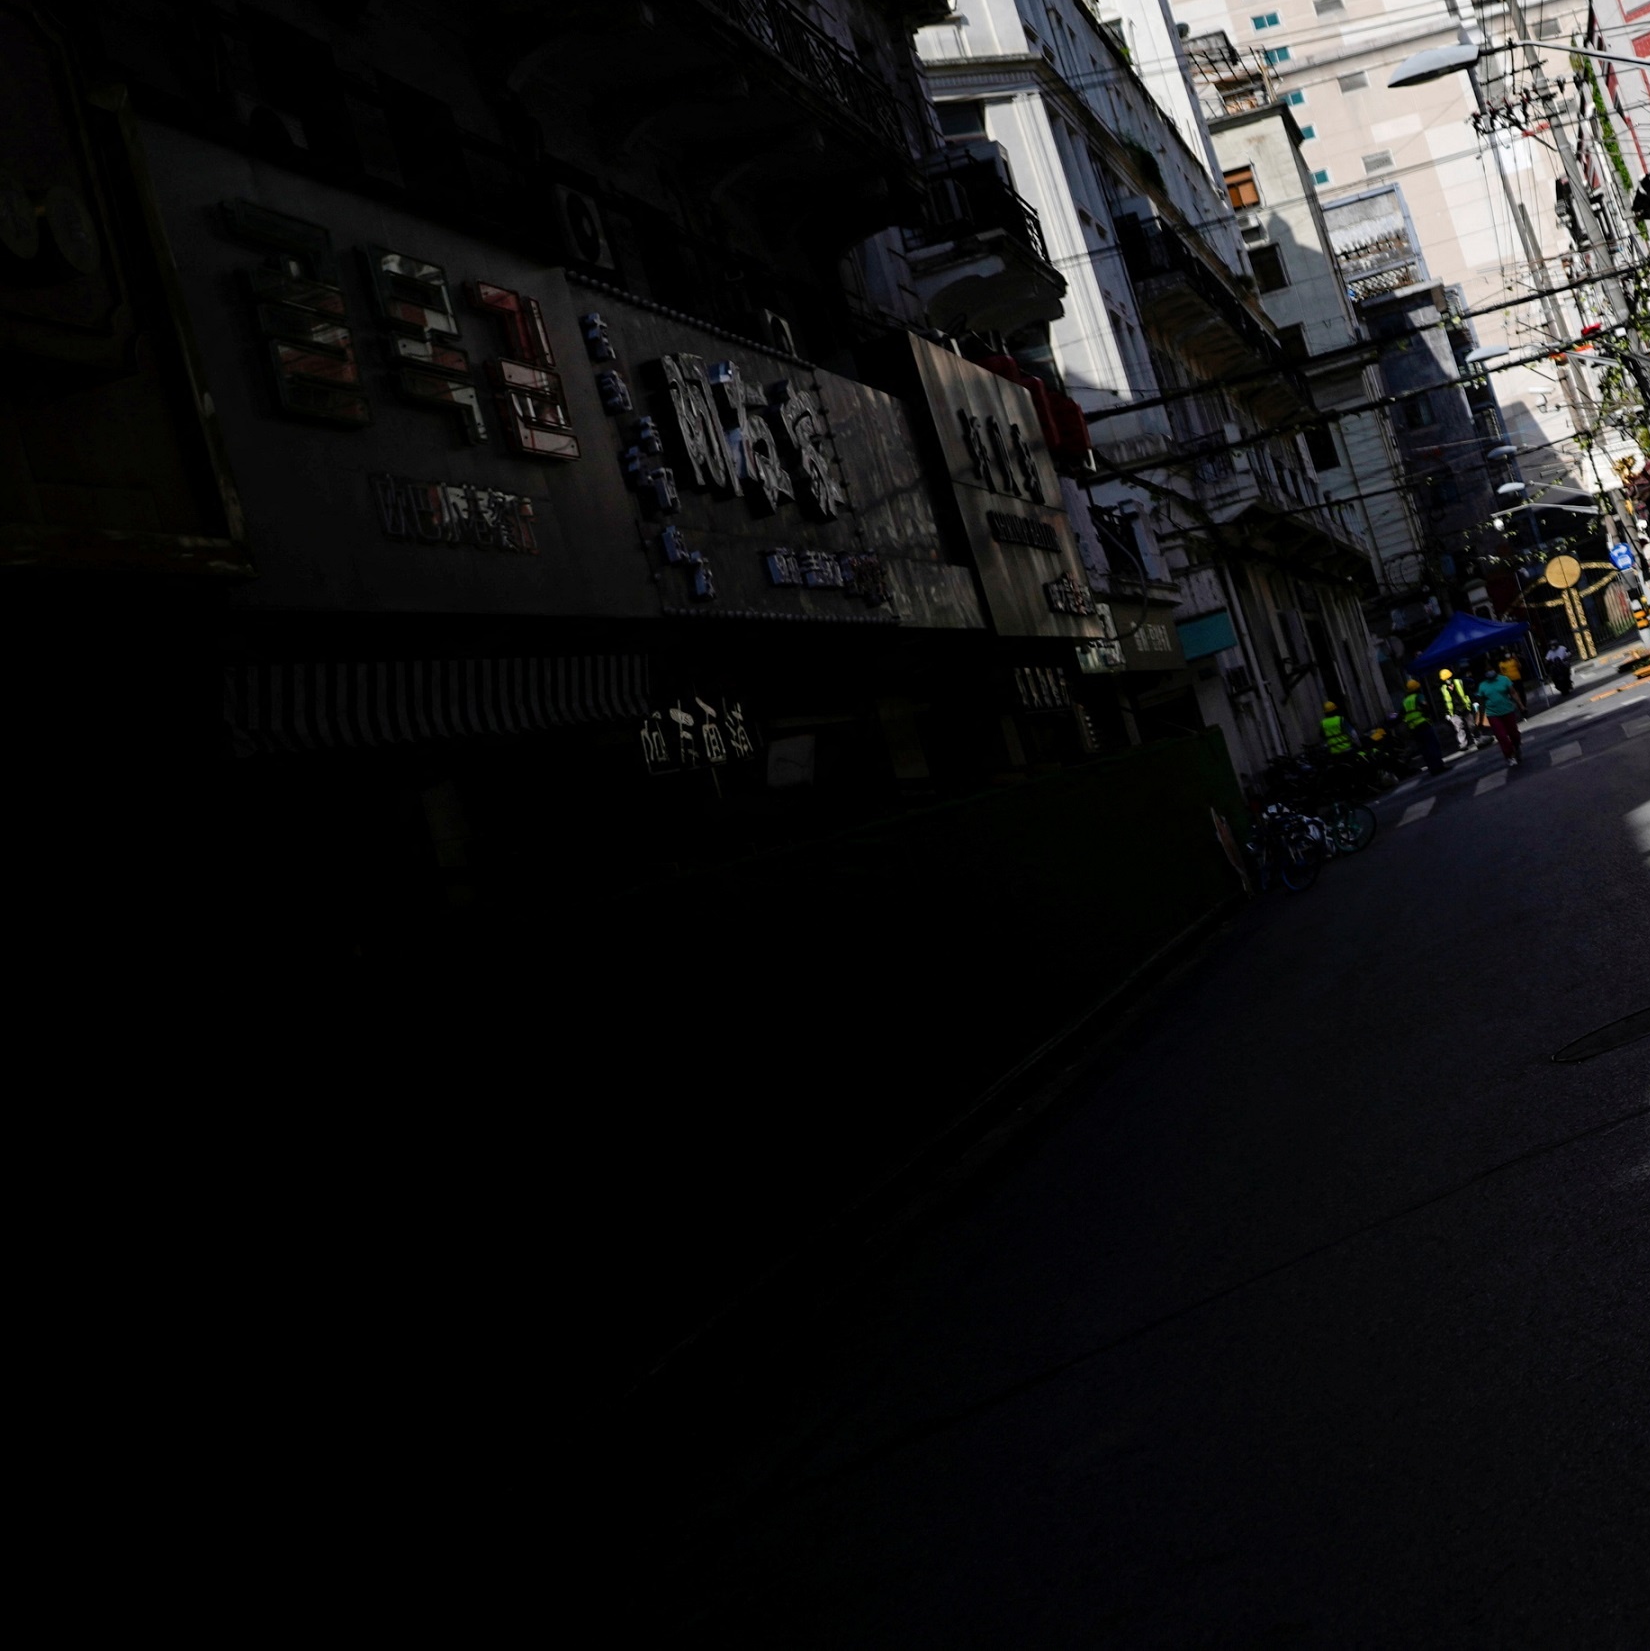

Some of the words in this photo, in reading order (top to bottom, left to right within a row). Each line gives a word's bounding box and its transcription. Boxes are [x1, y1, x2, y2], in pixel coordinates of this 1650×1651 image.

[369, 472, 540, 556] 欧巴小巷餐厅
